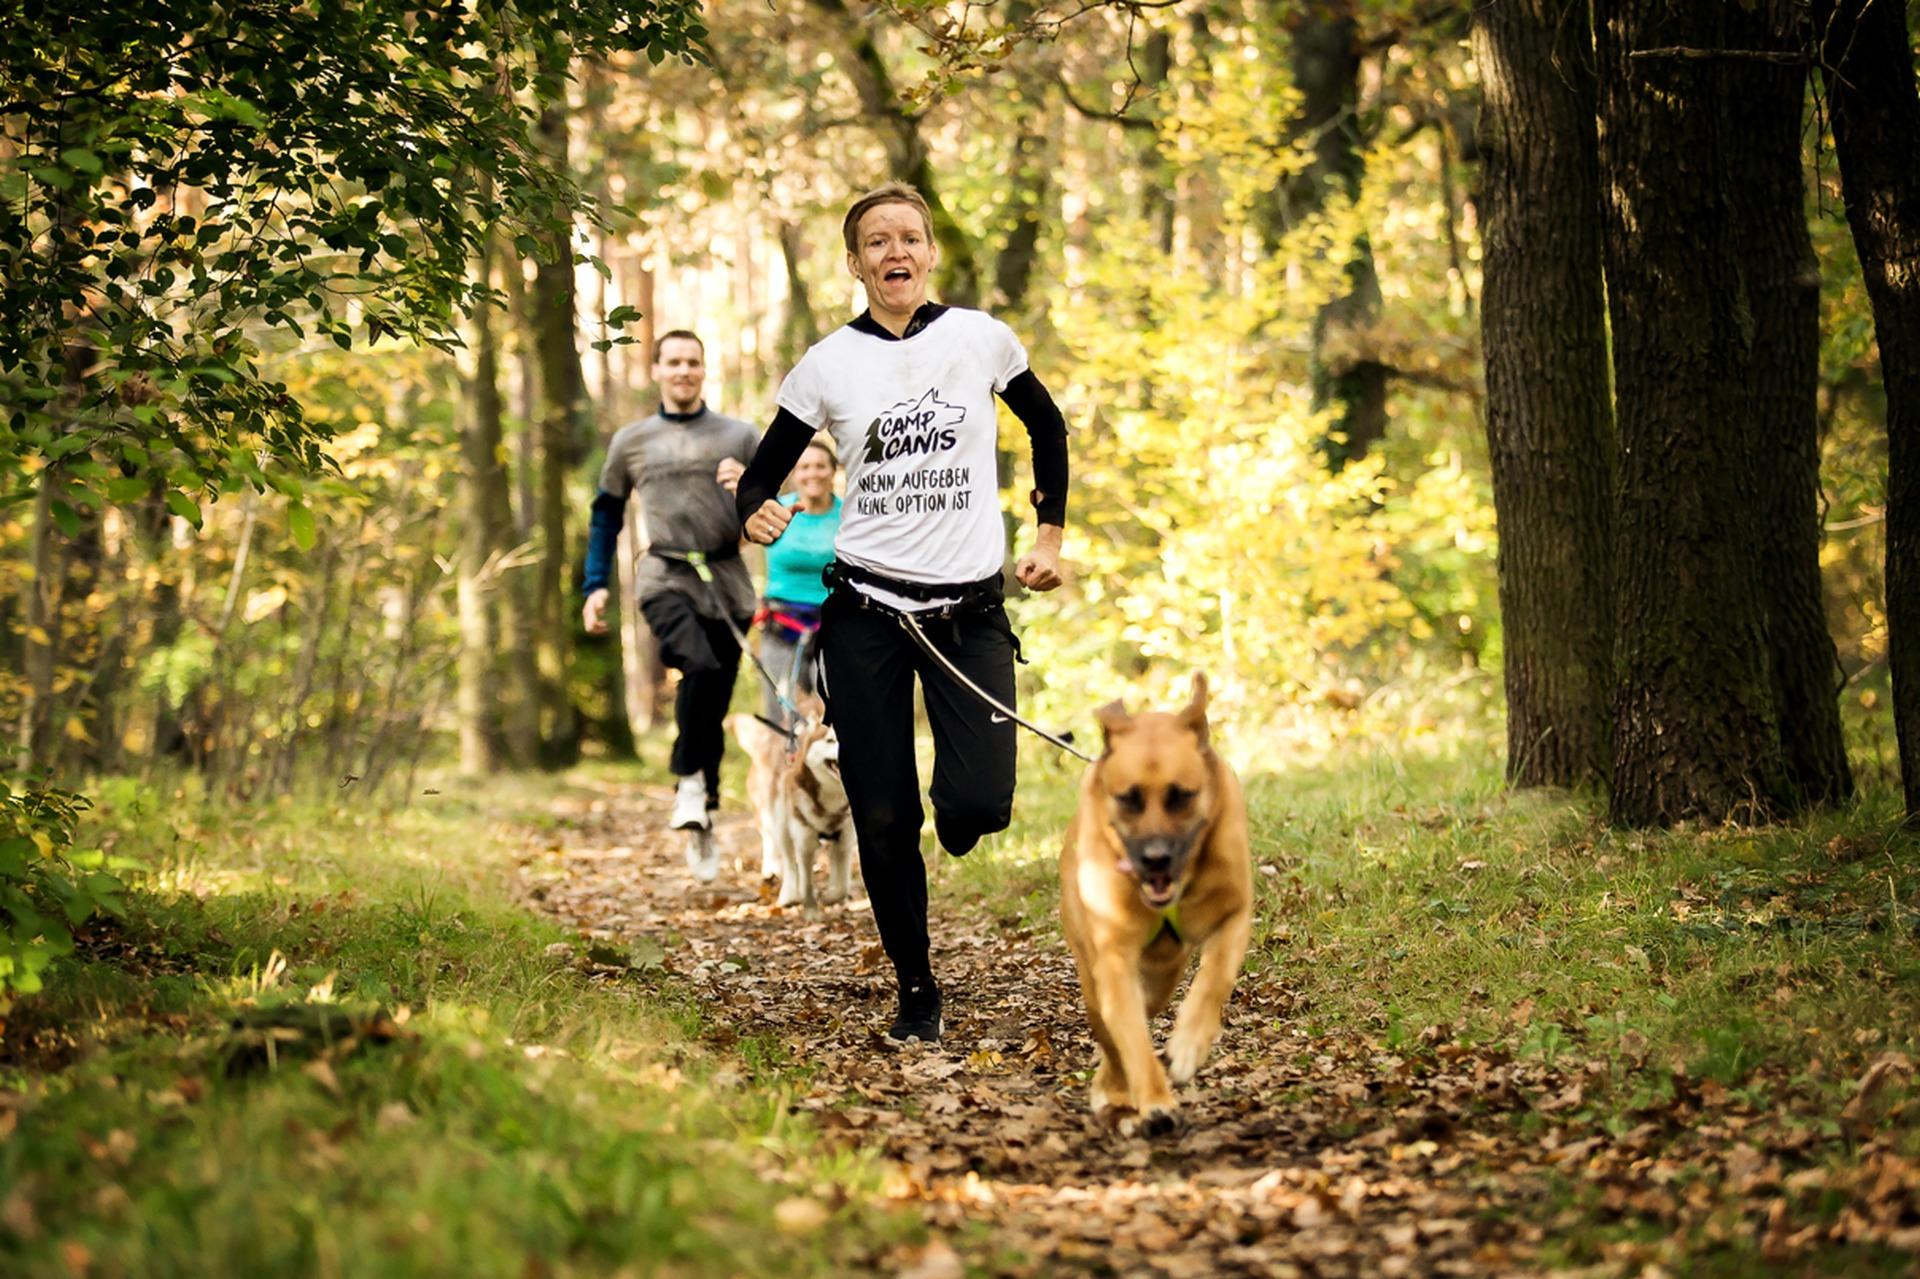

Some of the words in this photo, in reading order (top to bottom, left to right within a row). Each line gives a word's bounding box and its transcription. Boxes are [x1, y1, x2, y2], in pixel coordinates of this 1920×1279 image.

[881, 410, 936, 437] CAMP
[885, 426, 957, 460] CANIS
[858, 474, 895, 493] WENN
[902, 467, 969, 490] AUFGEBEN
[857, 496, 889, 516] KEINE
